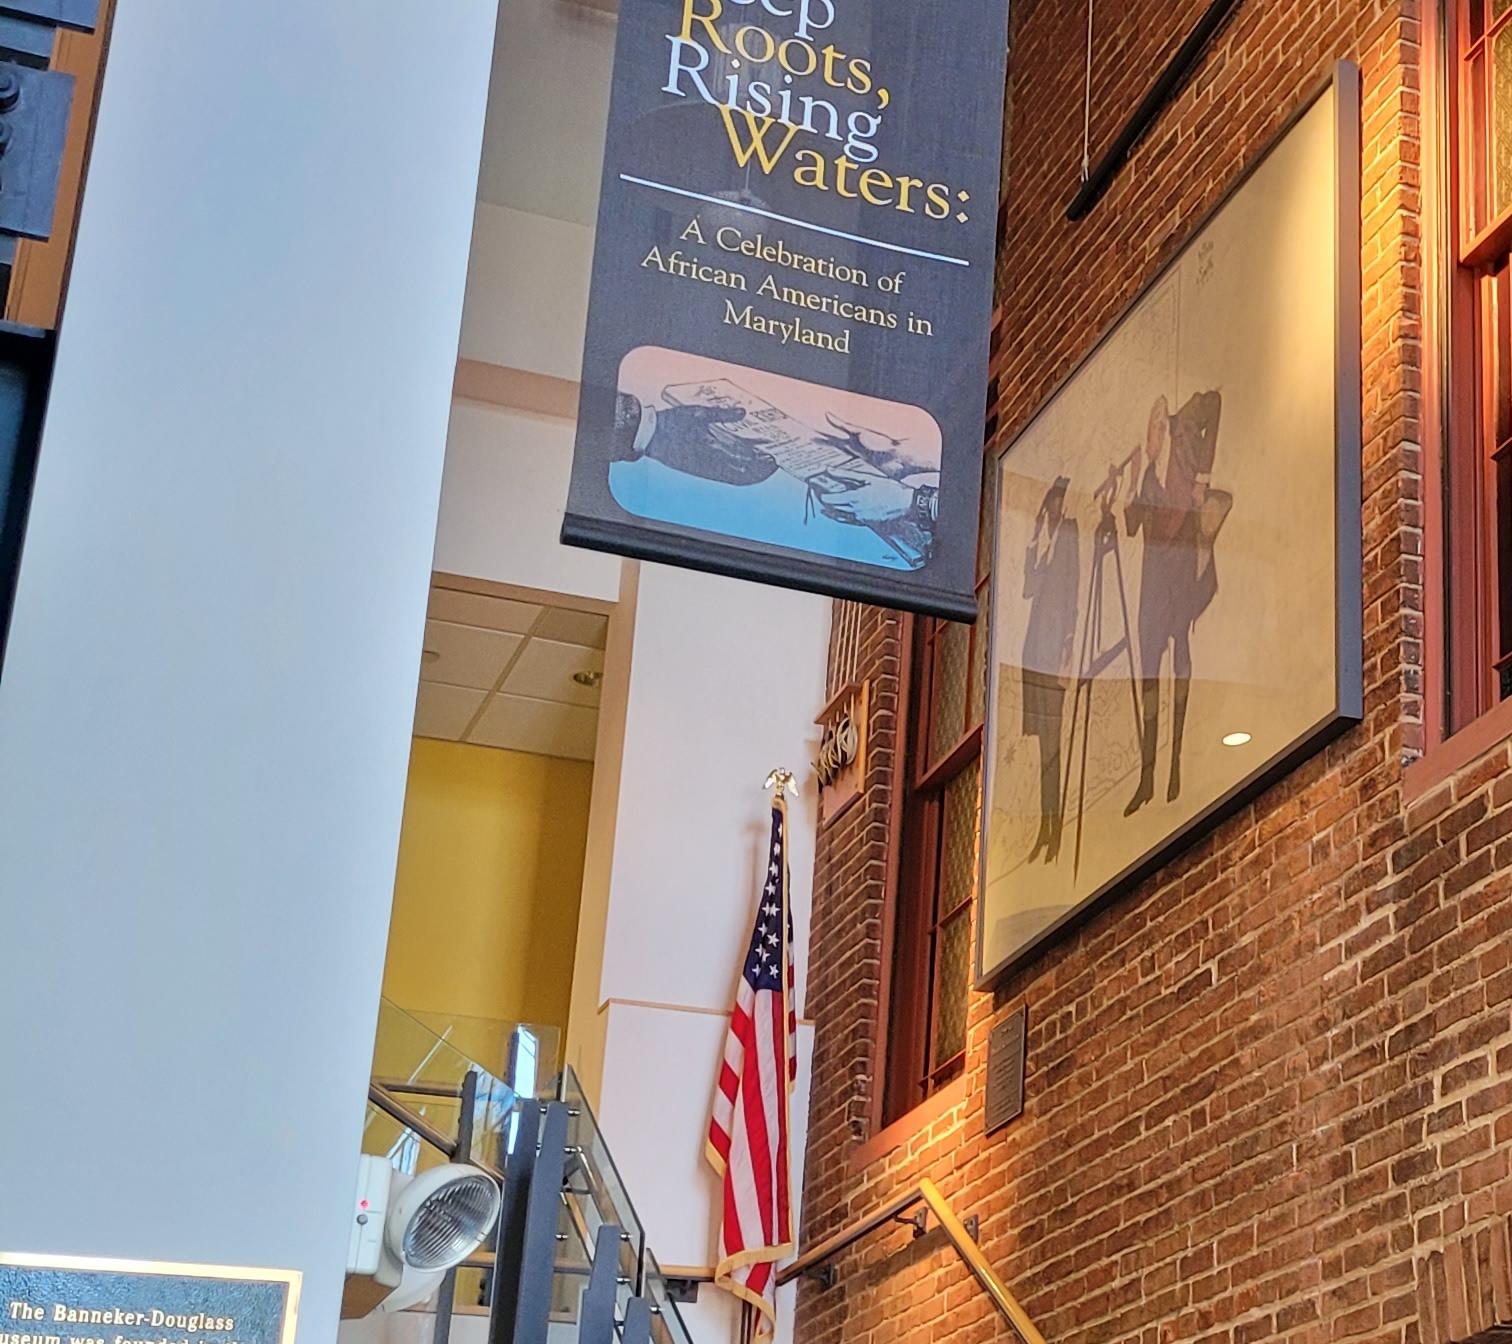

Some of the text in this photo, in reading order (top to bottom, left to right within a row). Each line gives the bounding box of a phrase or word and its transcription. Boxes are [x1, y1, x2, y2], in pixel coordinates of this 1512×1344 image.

[661, 34, 882, 163] Rising
[717, 103, 970, 224] Waters:
[641, 245, 934, 337] African Americans in
[679, 218, 906, 294] A Celebration of
[723, 298, 850, 354] Maryland
[10, 1302, 234, 1332] The Banneker-Douglass
